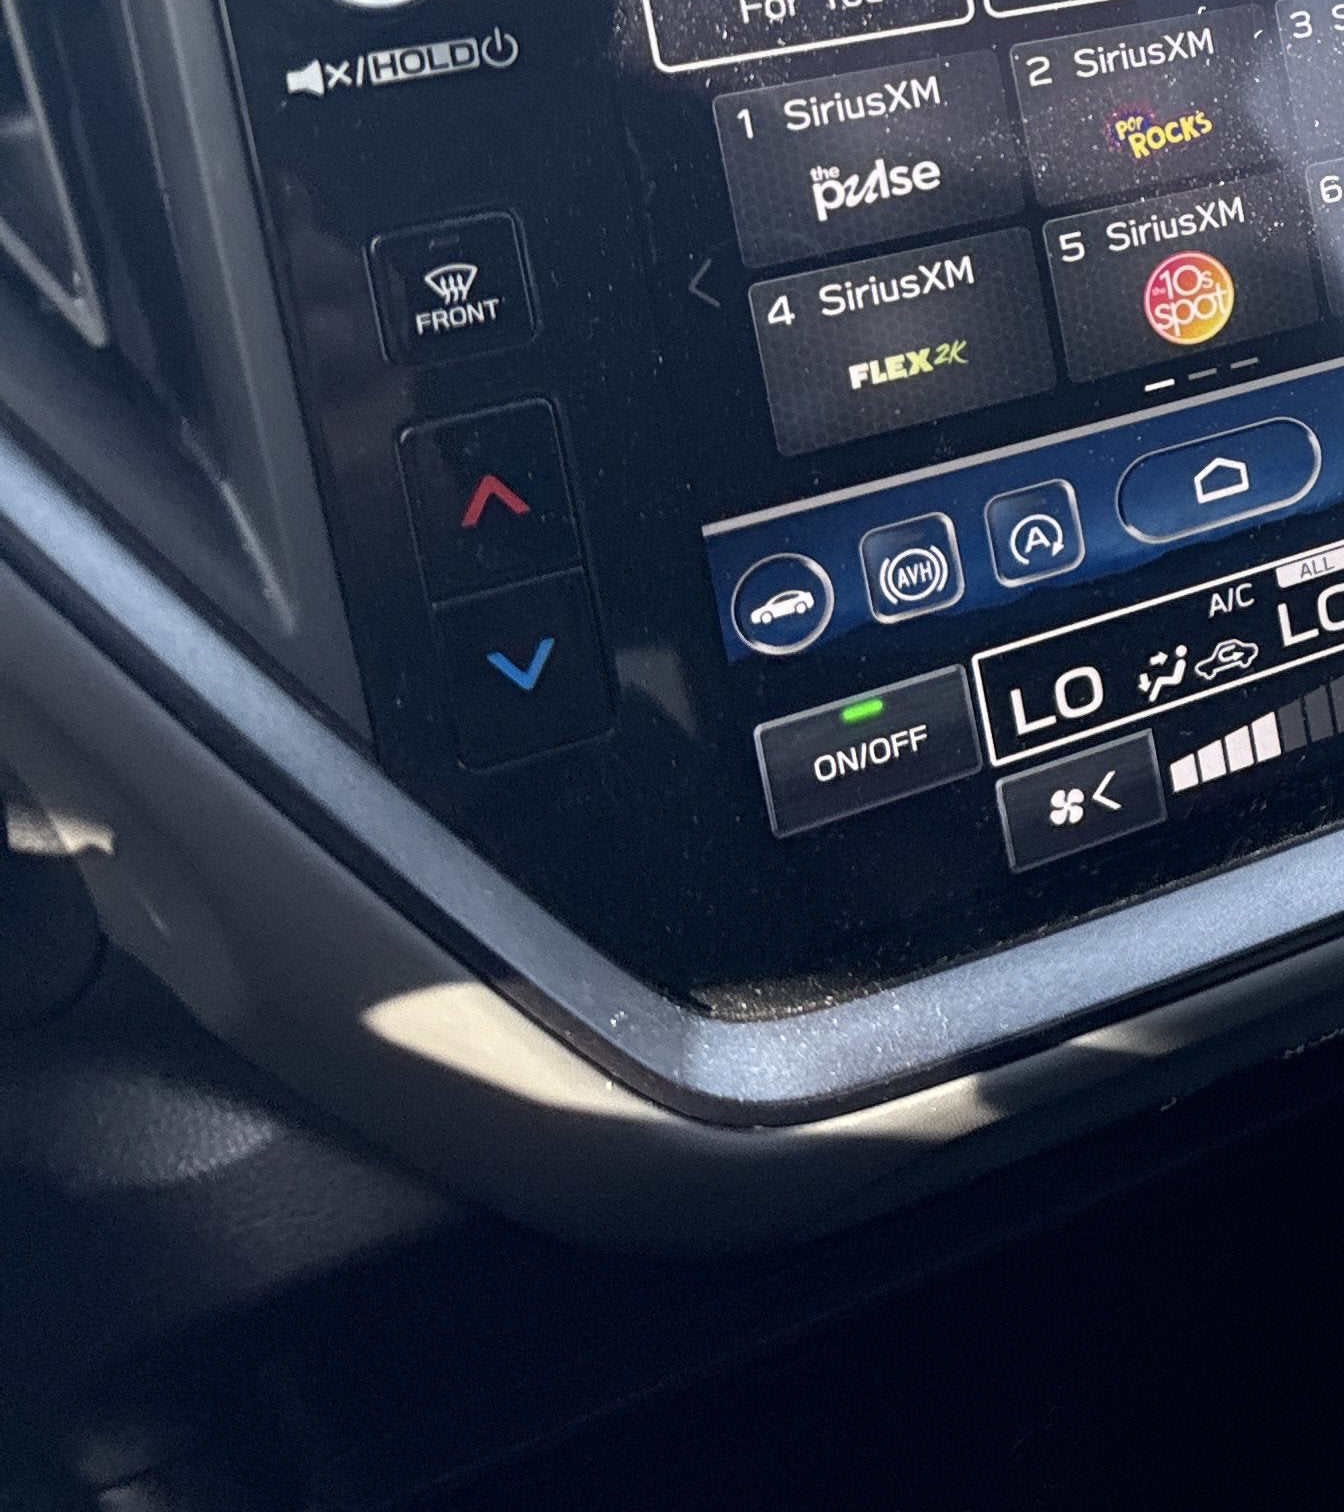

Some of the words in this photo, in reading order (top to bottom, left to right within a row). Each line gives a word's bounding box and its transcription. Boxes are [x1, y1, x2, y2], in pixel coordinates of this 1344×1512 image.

[1289, 9, 1314, 40] 3
[1025, 56, 1053, 87] 2
[1073, 27, 1215, 80] SiriusXM
[736, 108, 755, 140] 1
[783, 75, 941, 132] SiriusXM
[1128, 111, 1213, 159] ROCKS
[811, 164, 840, 182] the
[812, 158, 941, 223] pulse
[1319, 174, 1344, 204] 6
[1057, 230, 1086, 263] 5
[1105, 196, 1246, 253] SiriusXM
[766, 294, 797, 327] 4
[818, 255, 975, 317] SiriusXM
[1159, 264, 1214, 299] 10s
[415, 297, 499, 336] FRONT
[1154, 282, 1229, 337] spot
[896, 559, 934, 589] AVH
[1299, 556, 1336, 579] ALL
[1208, 582, 1256, 618] A/C
[1009, 665, 1105, 736] LO
[812, 724, 928, 783] ON/OFF
